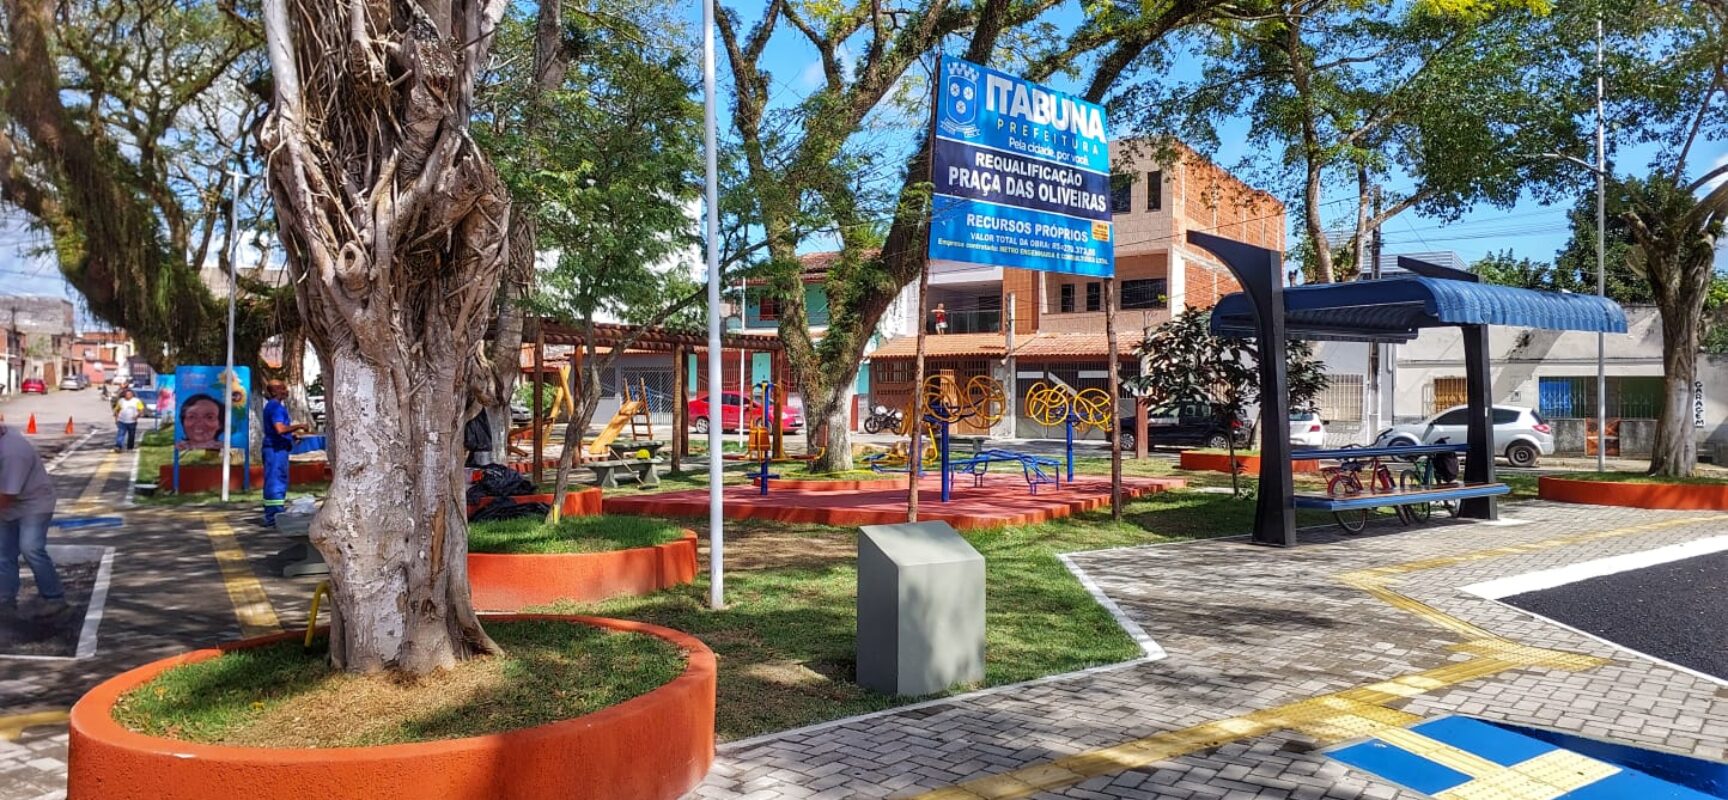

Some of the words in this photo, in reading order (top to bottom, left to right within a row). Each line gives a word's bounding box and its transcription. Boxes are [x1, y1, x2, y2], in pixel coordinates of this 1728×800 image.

[986, 74, 1107, 144] ITABUNA
[997, 119, 1098, 155] PREFEITURA
[1009, 136, 1027, 151] Pela
[1056, 151, 1071, 162] por
[975, 152, 1083, 186] REQUALIFICAÇÃO
[949, 166, 1001, 196] PRAÇA
[1006, 176, 1035, 199] DAS
[1038, 183, 1107, 212] OLIVEIRAS
[966, 213, 1032, 235] RECURSOS
[1035, 223, 1089, 243] PRÓPRIOS
[969, 231, 994, 242] VALOR
[996, 235, 1018, 245] TOTAL
[1019, 238, 1029, 246] DA
[1030, 240, 1050, 249] OBRA:
[1694, 380, 1704, 425] GARAGEM
